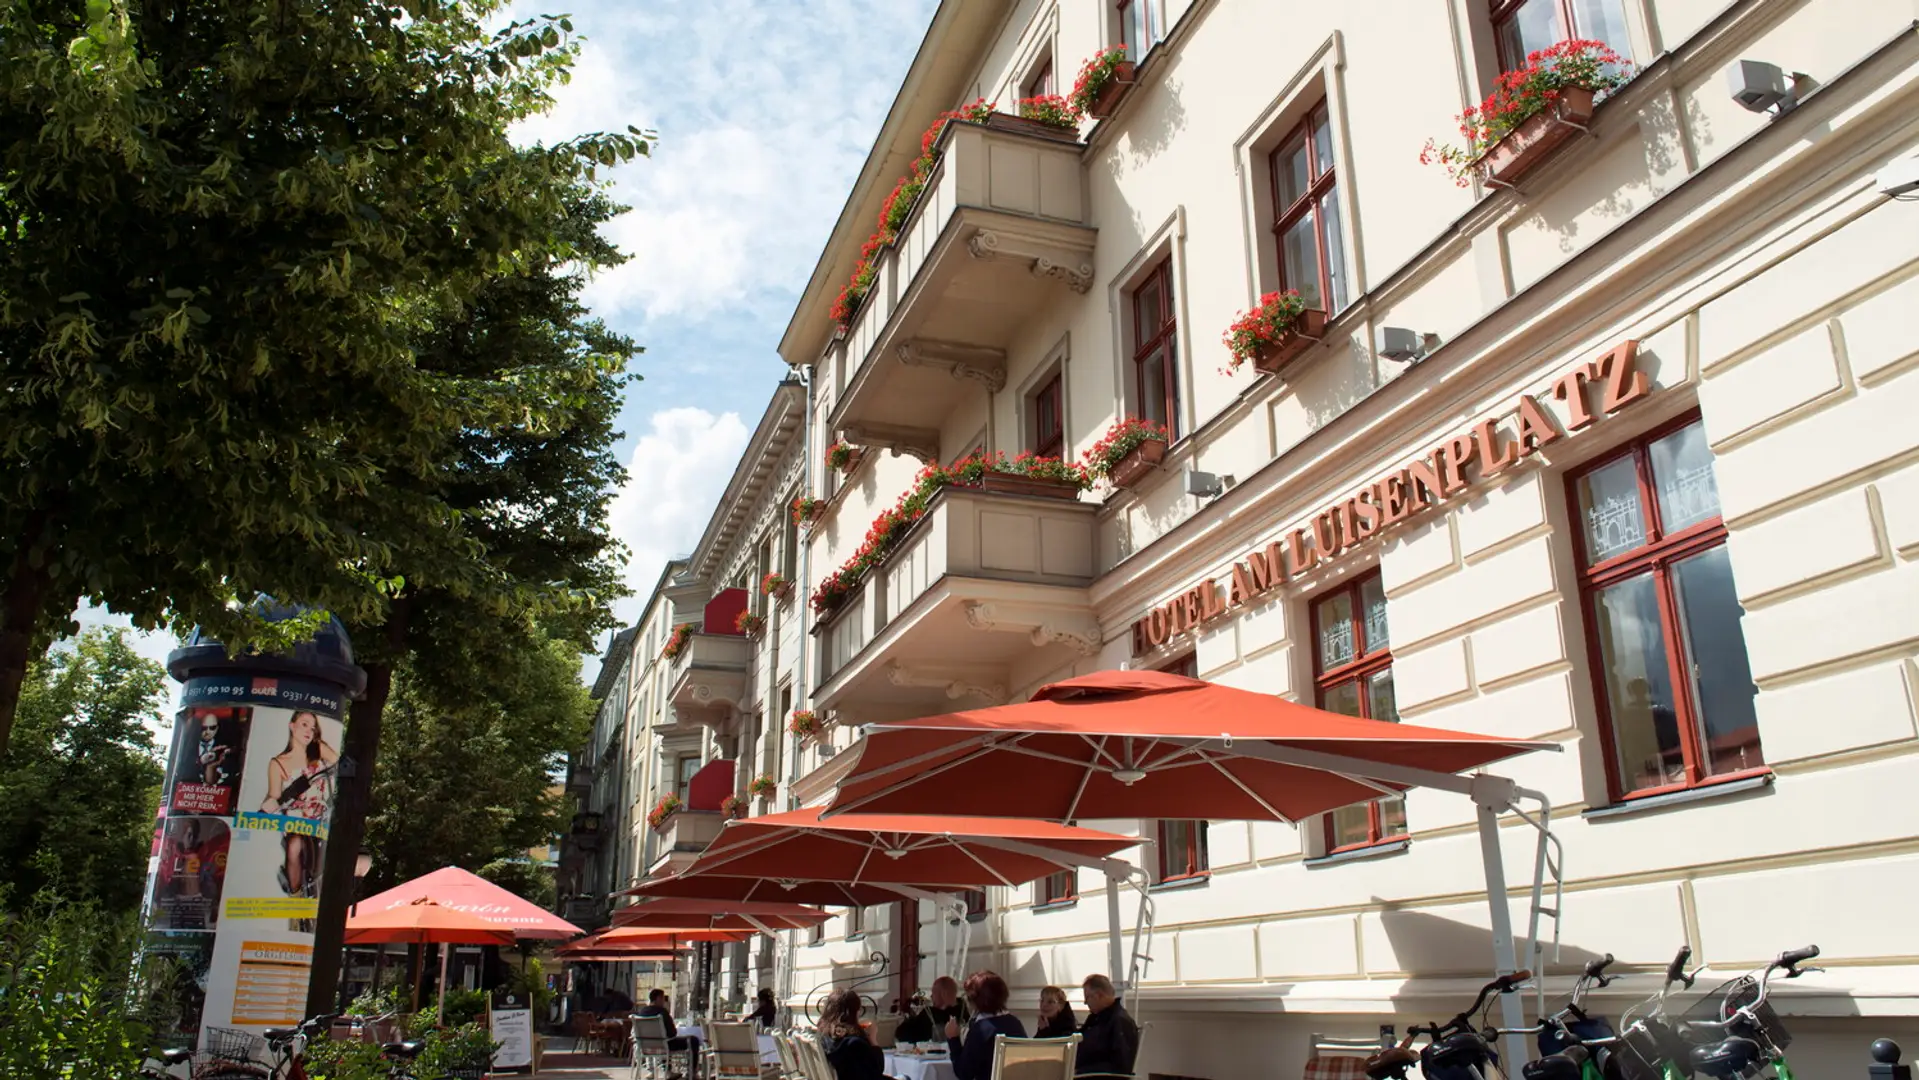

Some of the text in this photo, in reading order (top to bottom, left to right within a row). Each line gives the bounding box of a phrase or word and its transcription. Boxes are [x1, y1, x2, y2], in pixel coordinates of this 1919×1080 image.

[1131, 339, 1649, 659] HOTEL AM LUISENPLATZ
[232, 686, 244, 695] 95
[282, 690, 303, 701] 0331
[310, 695, 321, 704] 90
[195, 785, 226, 796] KOMMT
[183, 793, 215, 802] MIR HIER
[176, 799, 198, 808] NICHT
[236, 812, 280, 832] hans
[284, 819, 313, 836] otto
